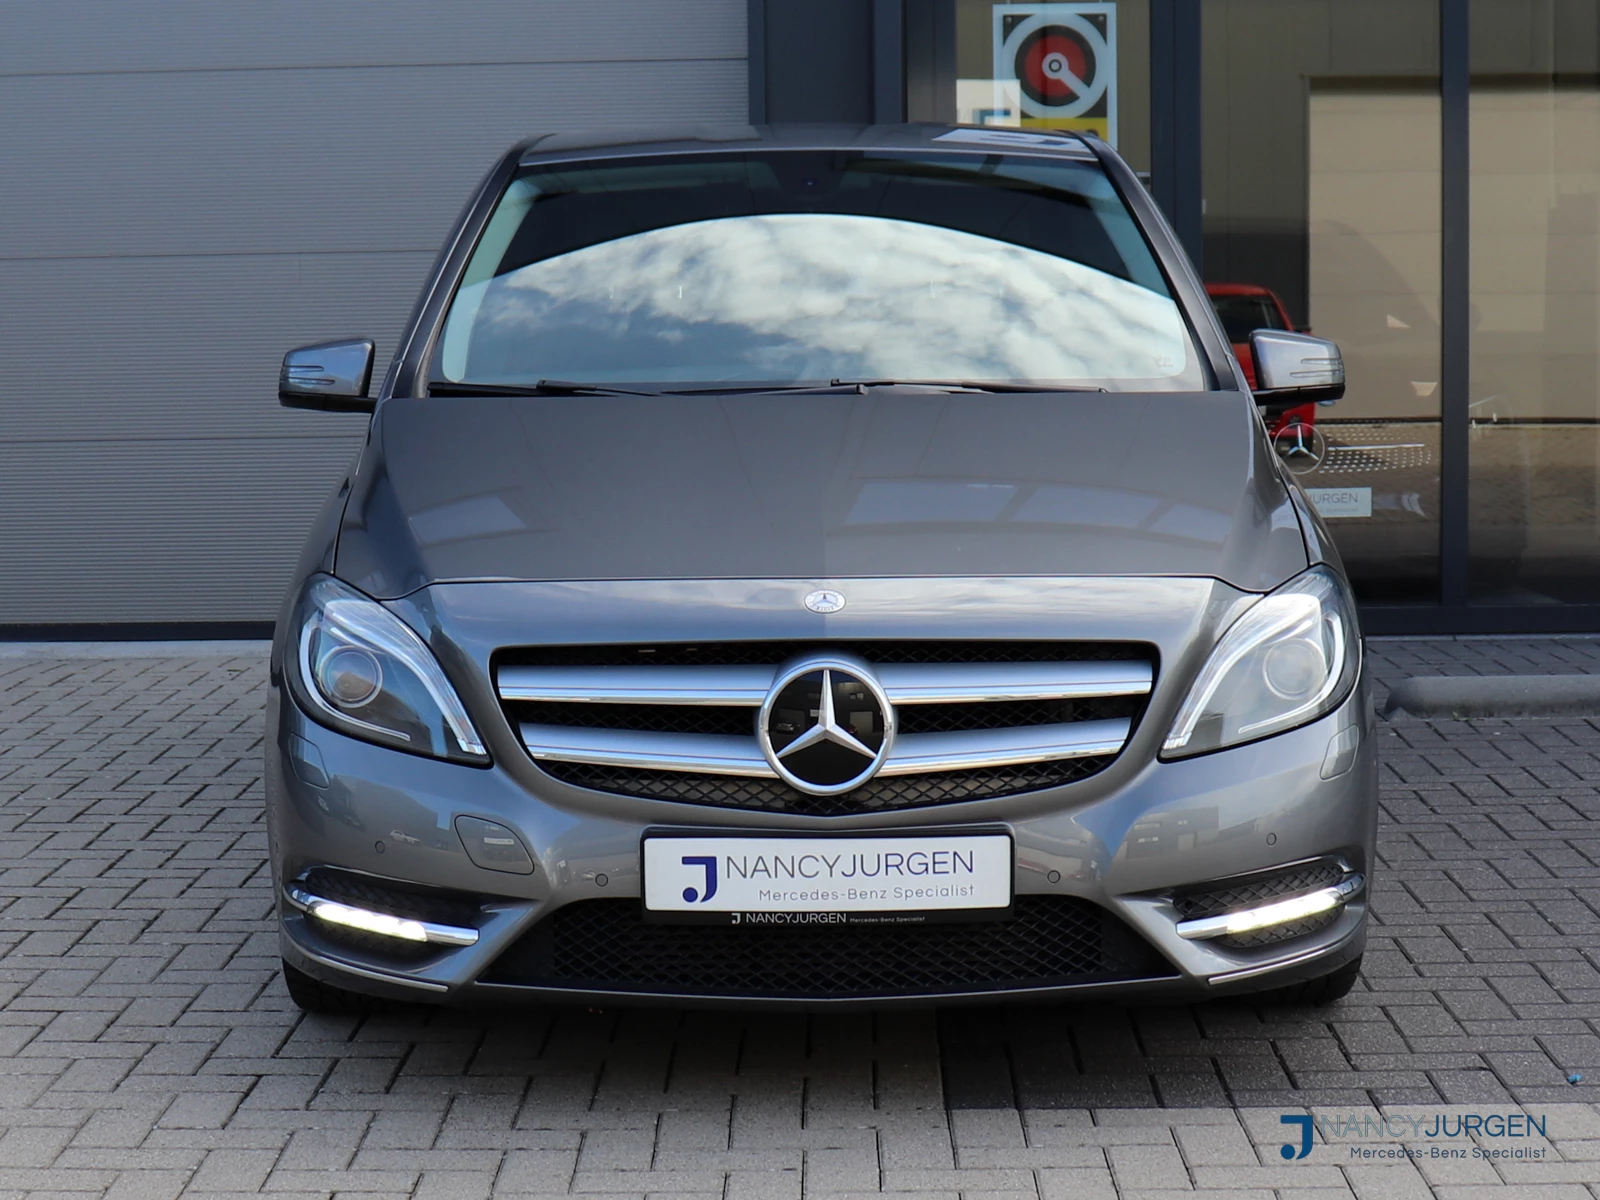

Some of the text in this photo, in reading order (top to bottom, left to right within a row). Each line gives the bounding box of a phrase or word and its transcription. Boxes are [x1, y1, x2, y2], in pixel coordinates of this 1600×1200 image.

[726, 850, 973, 879] NANCYJURGEN
[759, 885, 975, 901] Mercedes-Benz Specialist
[746, 913, 846, 924] NANCYJURGEN
